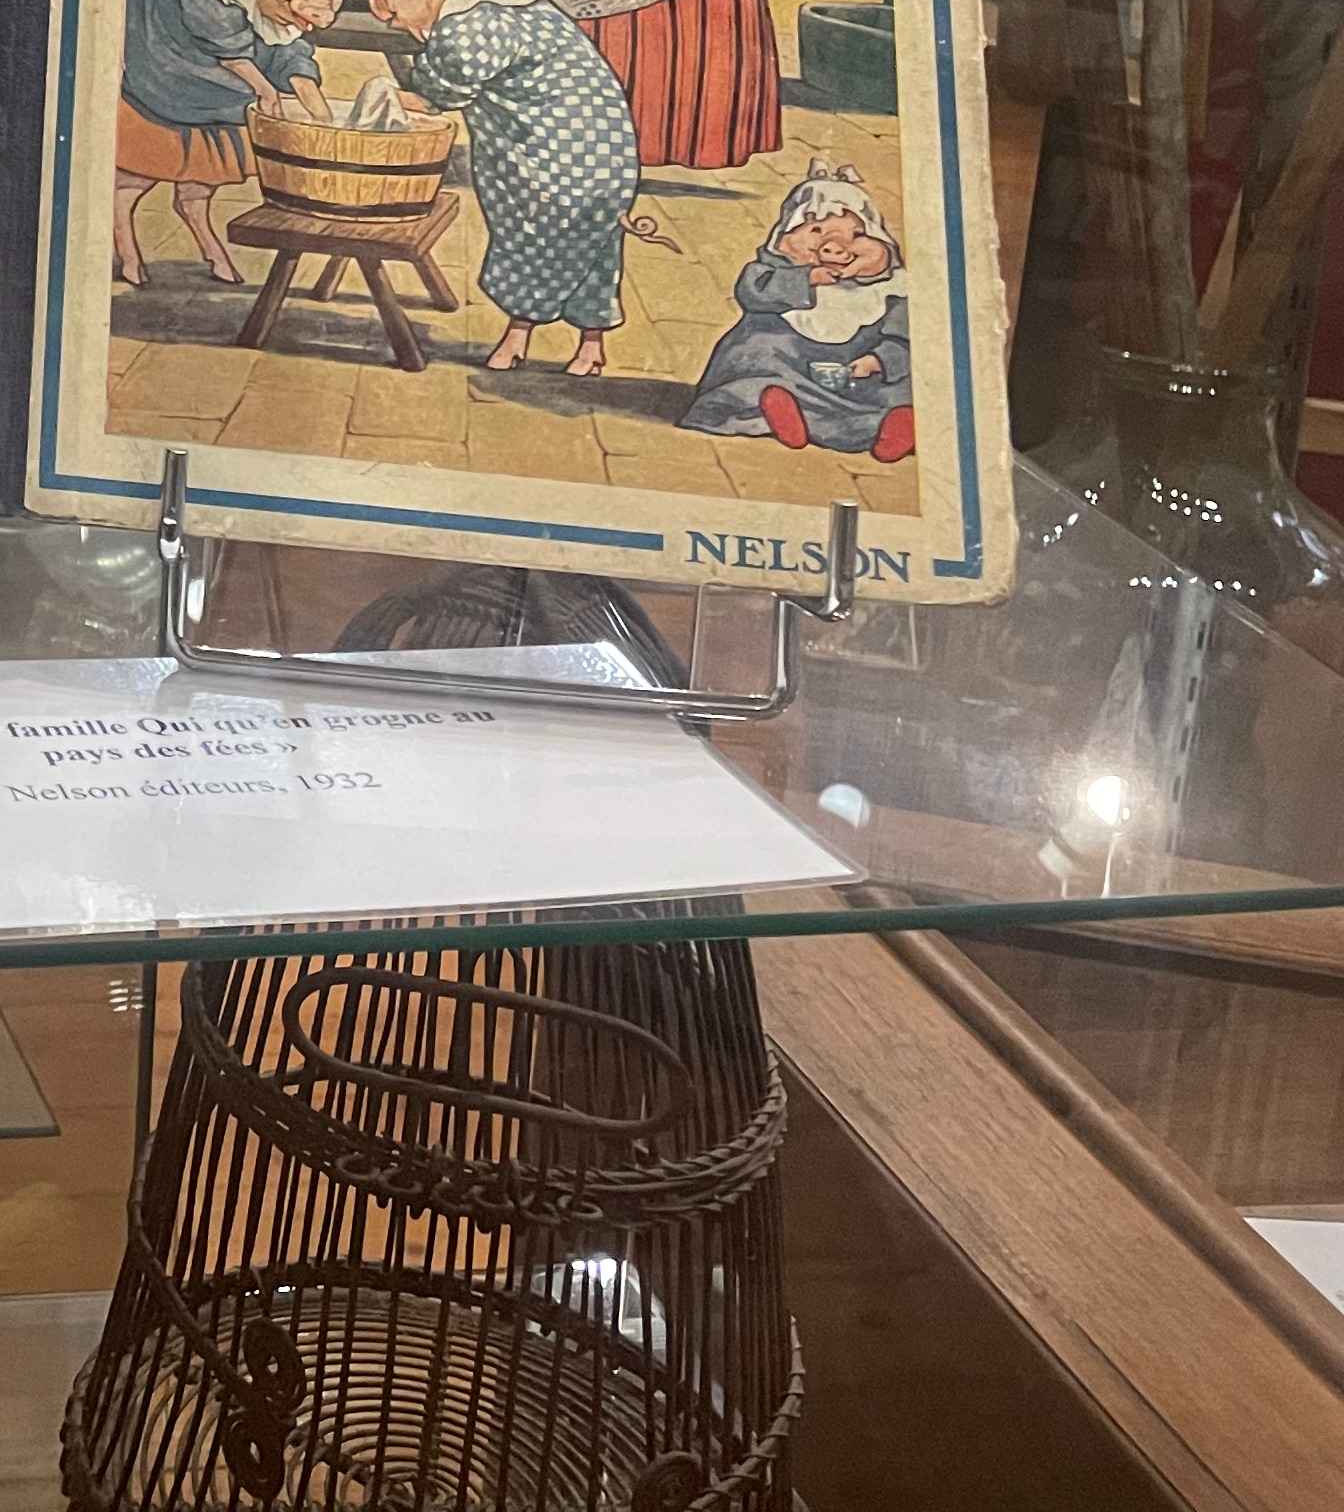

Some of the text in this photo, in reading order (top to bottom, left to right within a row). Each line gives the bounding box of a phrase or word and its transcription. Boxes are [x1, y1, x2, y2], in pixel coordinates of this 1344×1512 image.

[8, 717, 128, 739] famille
[136, 716, 204, 737] Qui
[323, 710, 444, 731] grogne
[452, 710, 496, 724] au
[41, 745, 124, 766] pays
[134, 740, 191, 760] des
[202, 739, 267, 758] fées
[5, 772, 383, 802] Nelson éditeurs, 1932
